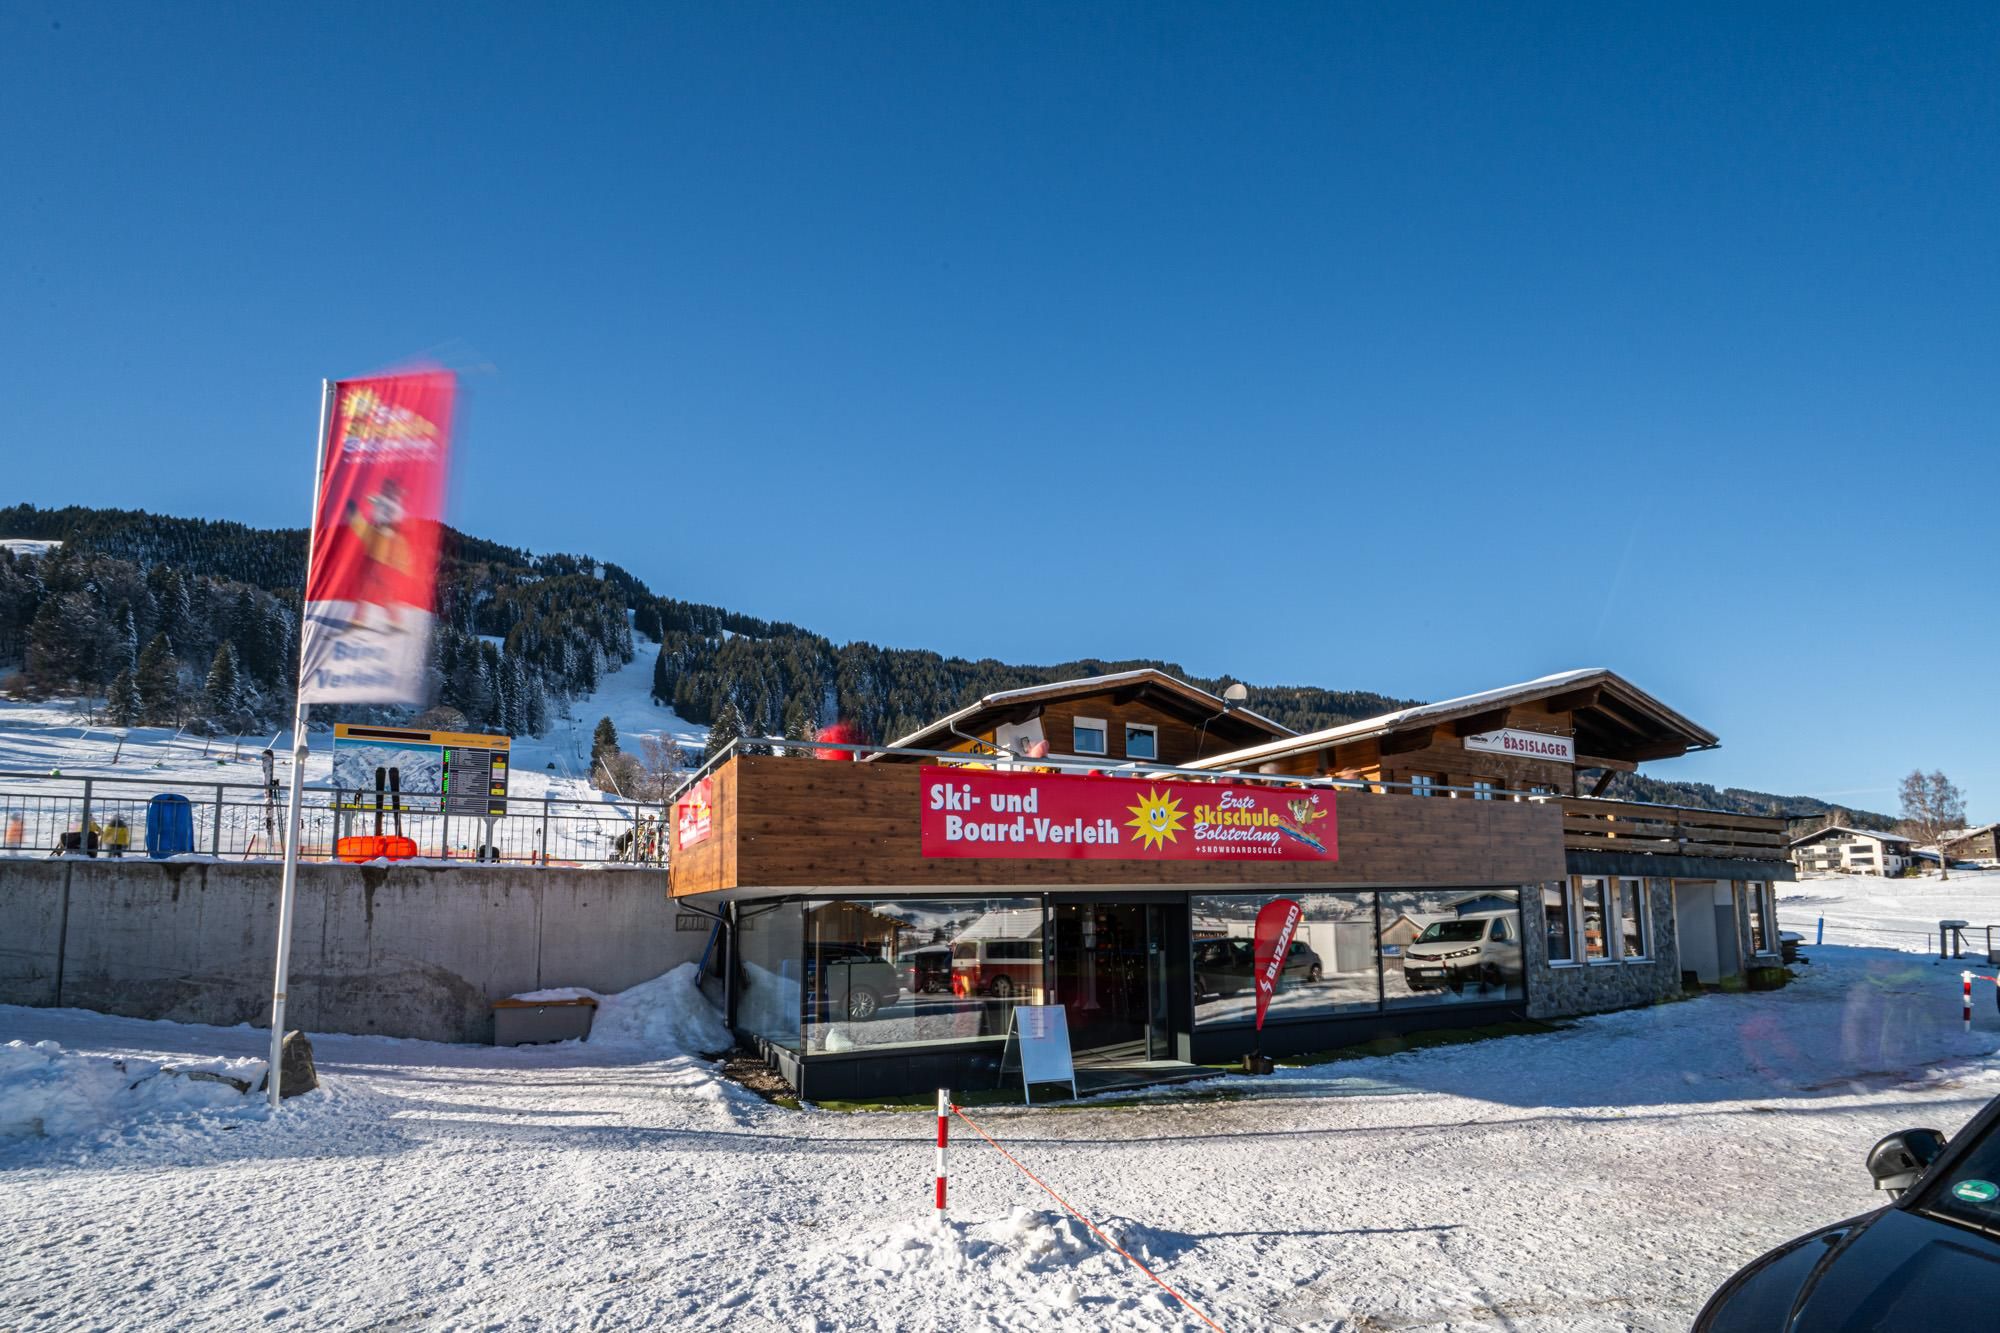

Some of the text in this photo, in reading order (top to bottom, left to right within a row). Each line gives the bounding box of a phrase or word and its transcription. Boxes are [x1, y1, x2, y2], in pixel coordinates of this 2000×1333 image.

[1503, 736, 1568, 757] BASISLAGER
[930, 783, 1038, 813] Ski- und
[1220, 791, 1255, 809] Erste
[1193, 805, 1280, 827] Skischule
[945, 814, 1119, 844] Board-Verleih
[1193, 823, 1281, 847] Bolsterlang
[1266, 905, 1299, 980] BLIZZARD
